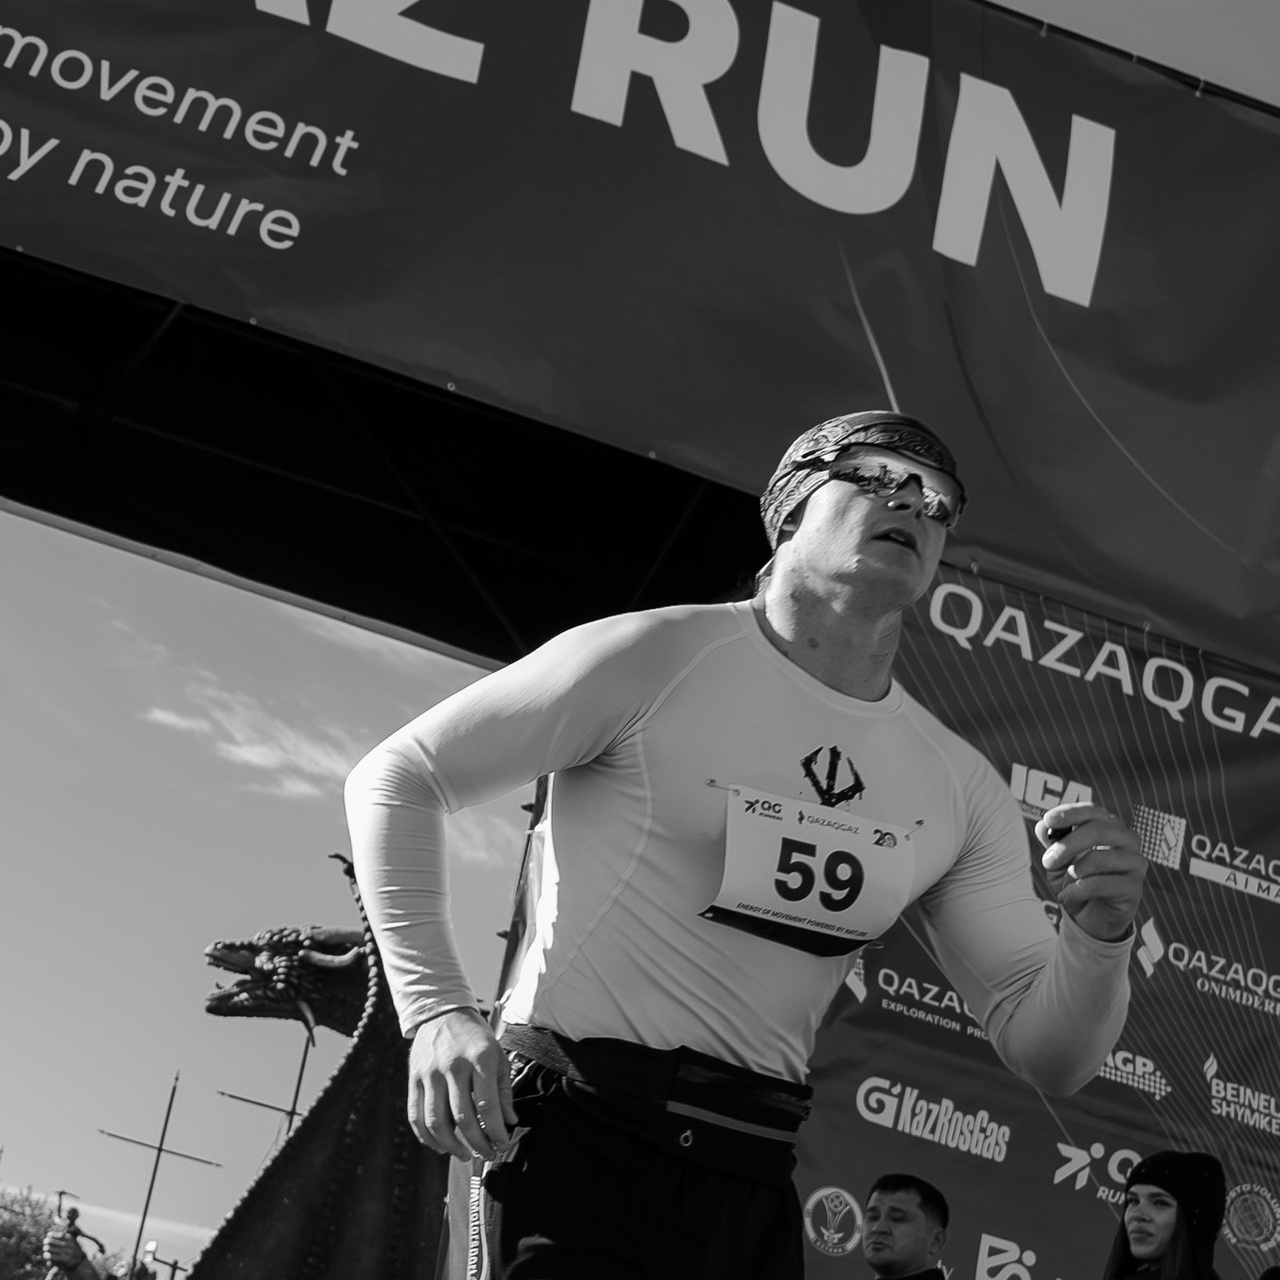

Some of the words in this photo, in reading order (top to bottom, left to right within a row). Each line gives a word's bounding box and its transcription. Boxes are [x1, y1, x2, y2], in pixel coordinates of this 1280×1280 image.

[68, 147, 301, 250] nature
[774, 836, 864, 912] 59
[881, 998, 961, 1032] EXPLORATION
[897, 1086, 1010, 1163] KazRosGas
